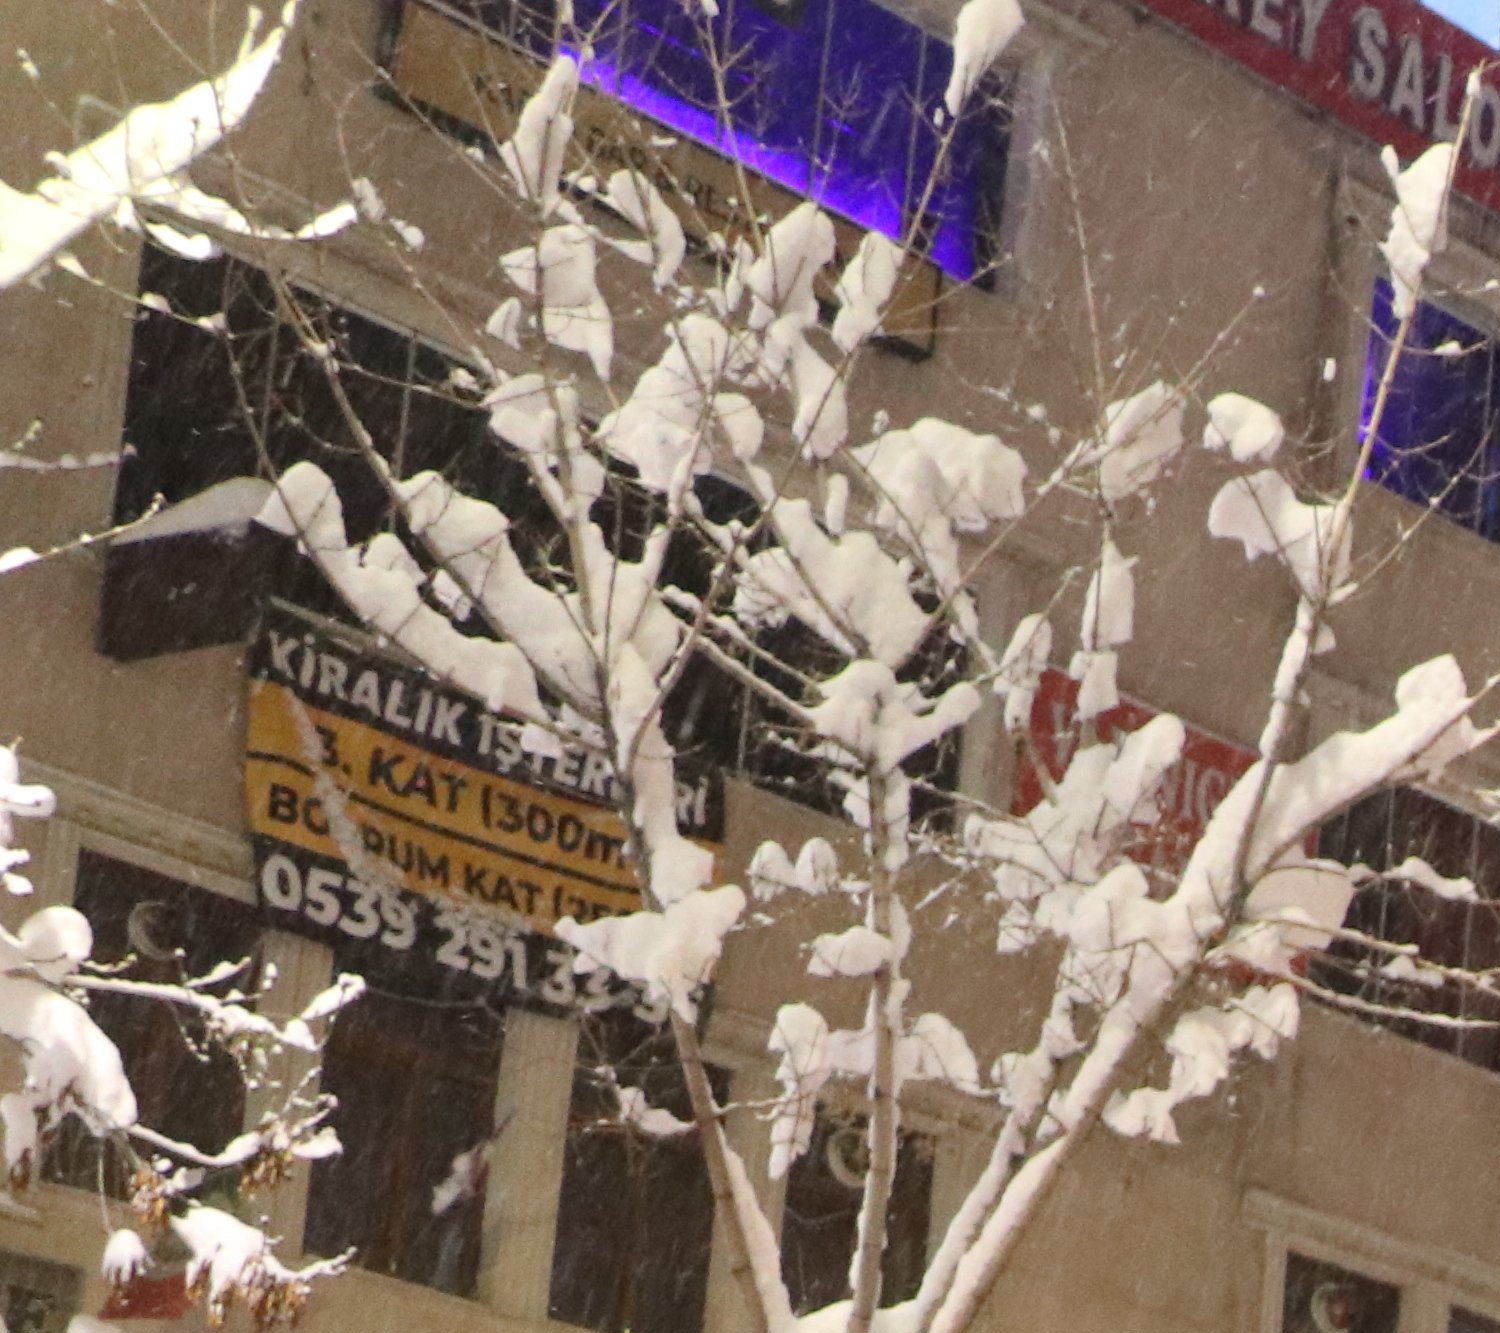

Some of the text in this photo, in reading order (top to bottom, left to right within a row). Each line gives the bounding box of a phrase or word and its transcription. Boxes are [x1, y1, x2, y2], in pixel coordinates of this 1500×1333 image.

[268, 631, 464, 746] KİRALIK
[368, 746, 468, 813] KAT
[268, 782, 450, 888] BORUM
[464, 861, 546, 918] KAT
[261, 853, 418, 951] 0539
[434, 901, 530, 990] 291
